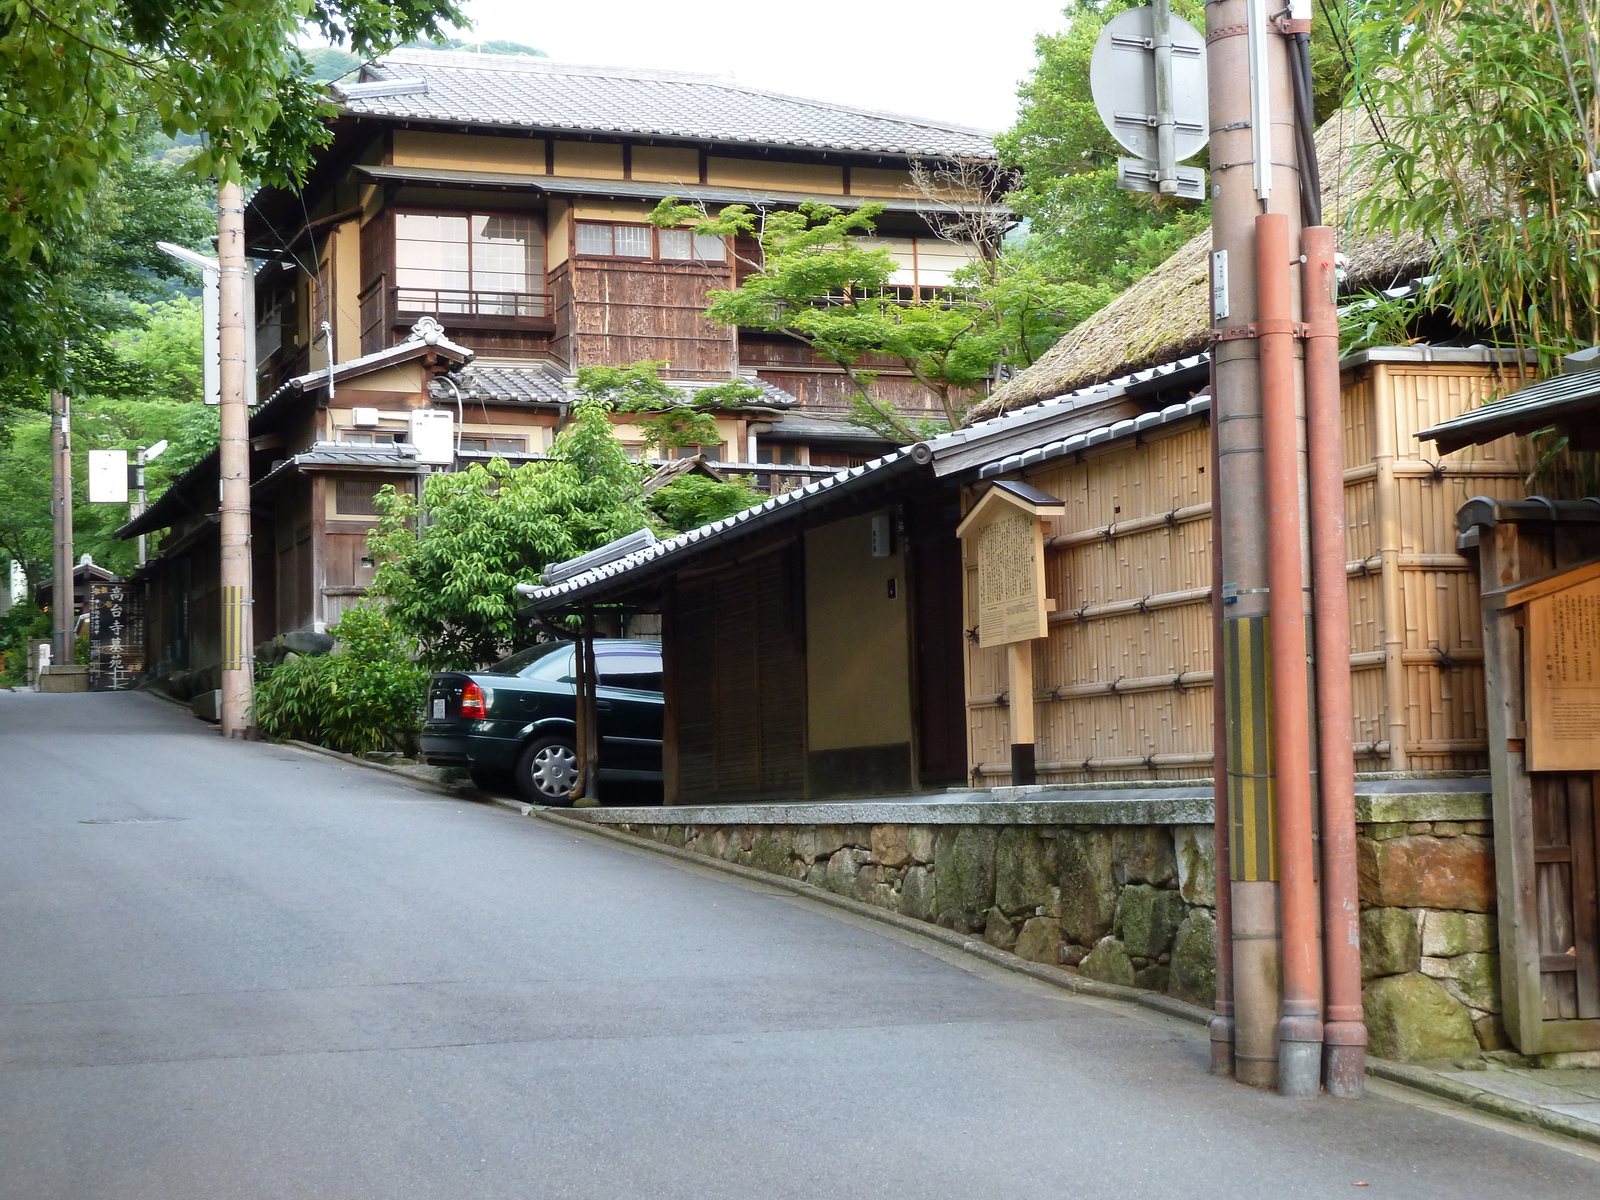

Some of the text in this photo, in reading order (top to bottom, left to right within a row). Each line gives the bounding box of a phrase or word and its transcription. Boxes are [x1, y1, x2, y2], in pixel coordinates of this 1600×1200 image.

[109, 586, 124, 669] 高台寺墓苑
